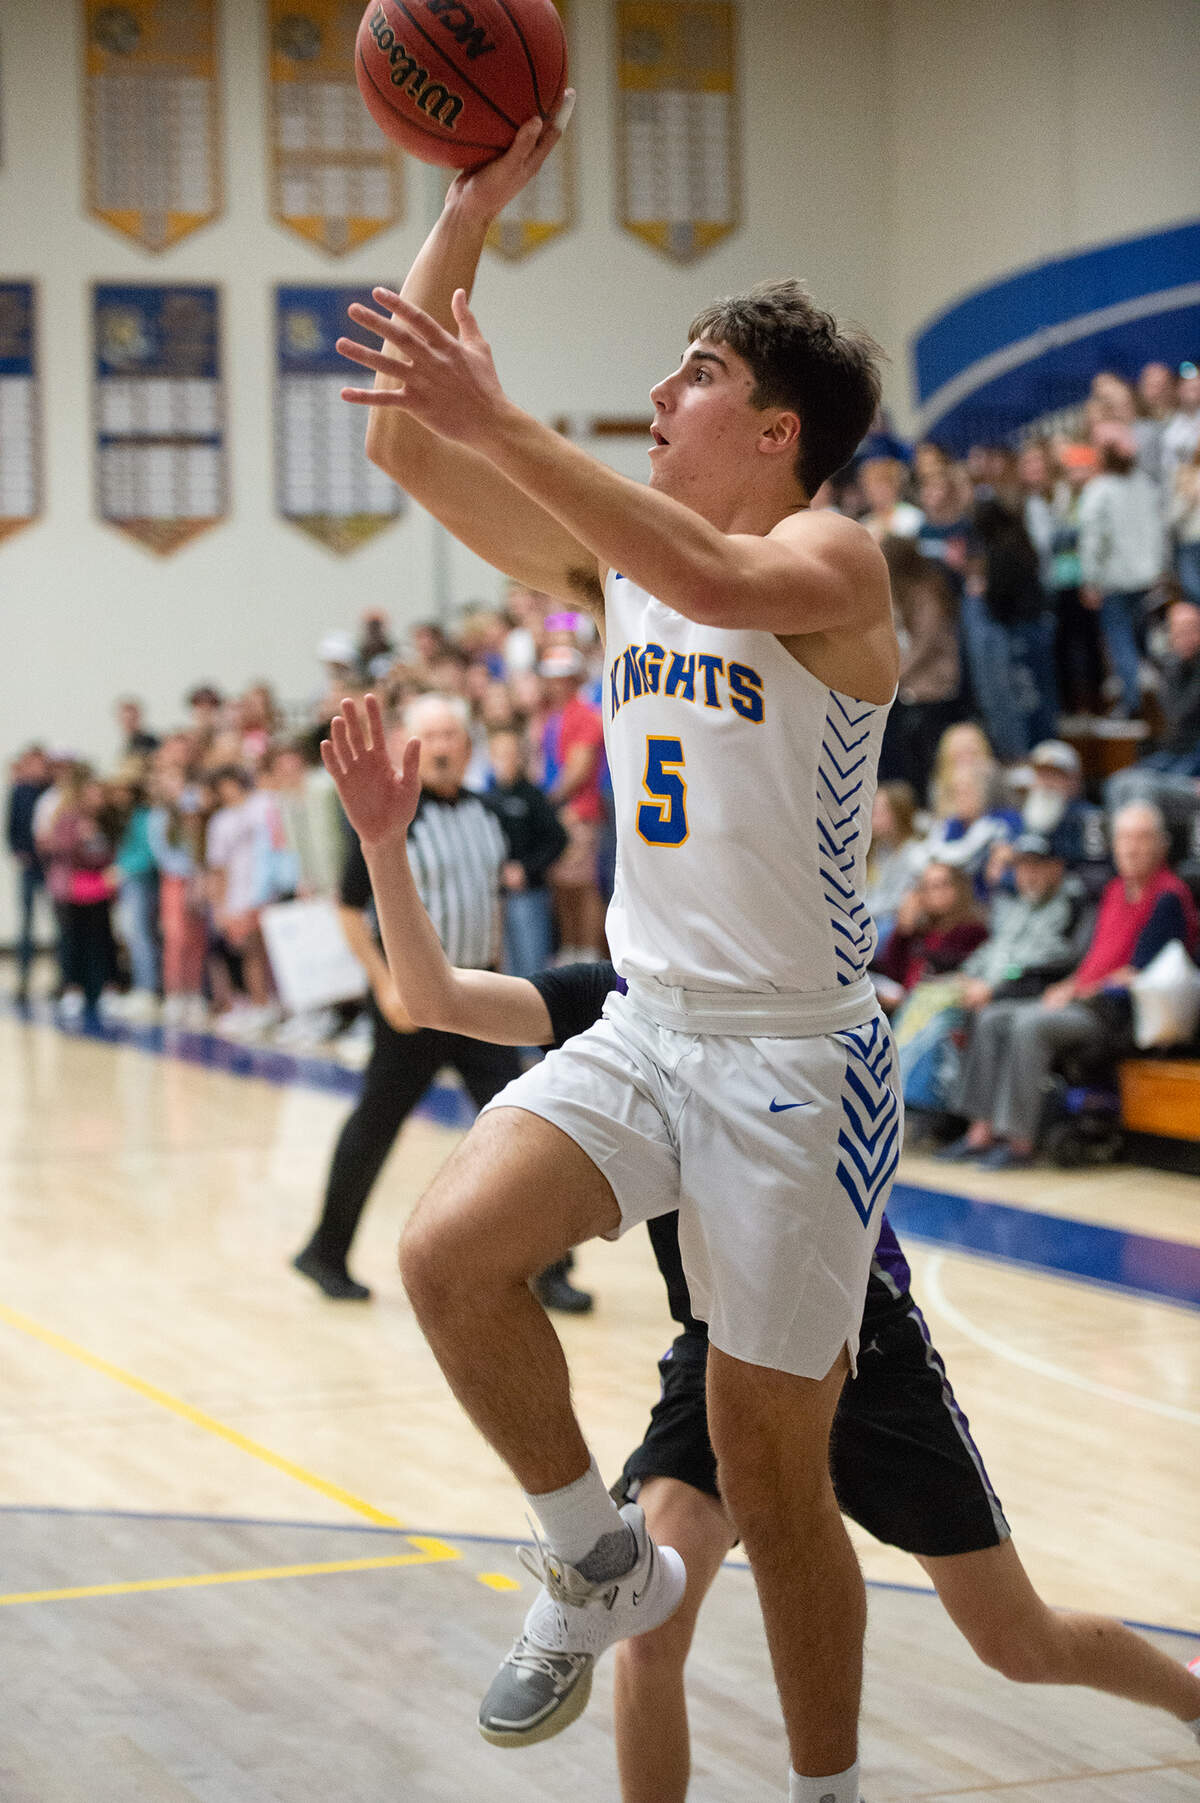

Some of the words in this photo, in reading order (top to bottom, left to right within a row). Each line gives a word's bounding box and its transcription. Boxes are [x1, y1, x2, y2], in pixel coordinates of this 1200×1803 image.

[370, 5, 463, 130] Wilson
[610, 643, 766, 724] KNGHTS
[636, 734, 690, 848] 5
